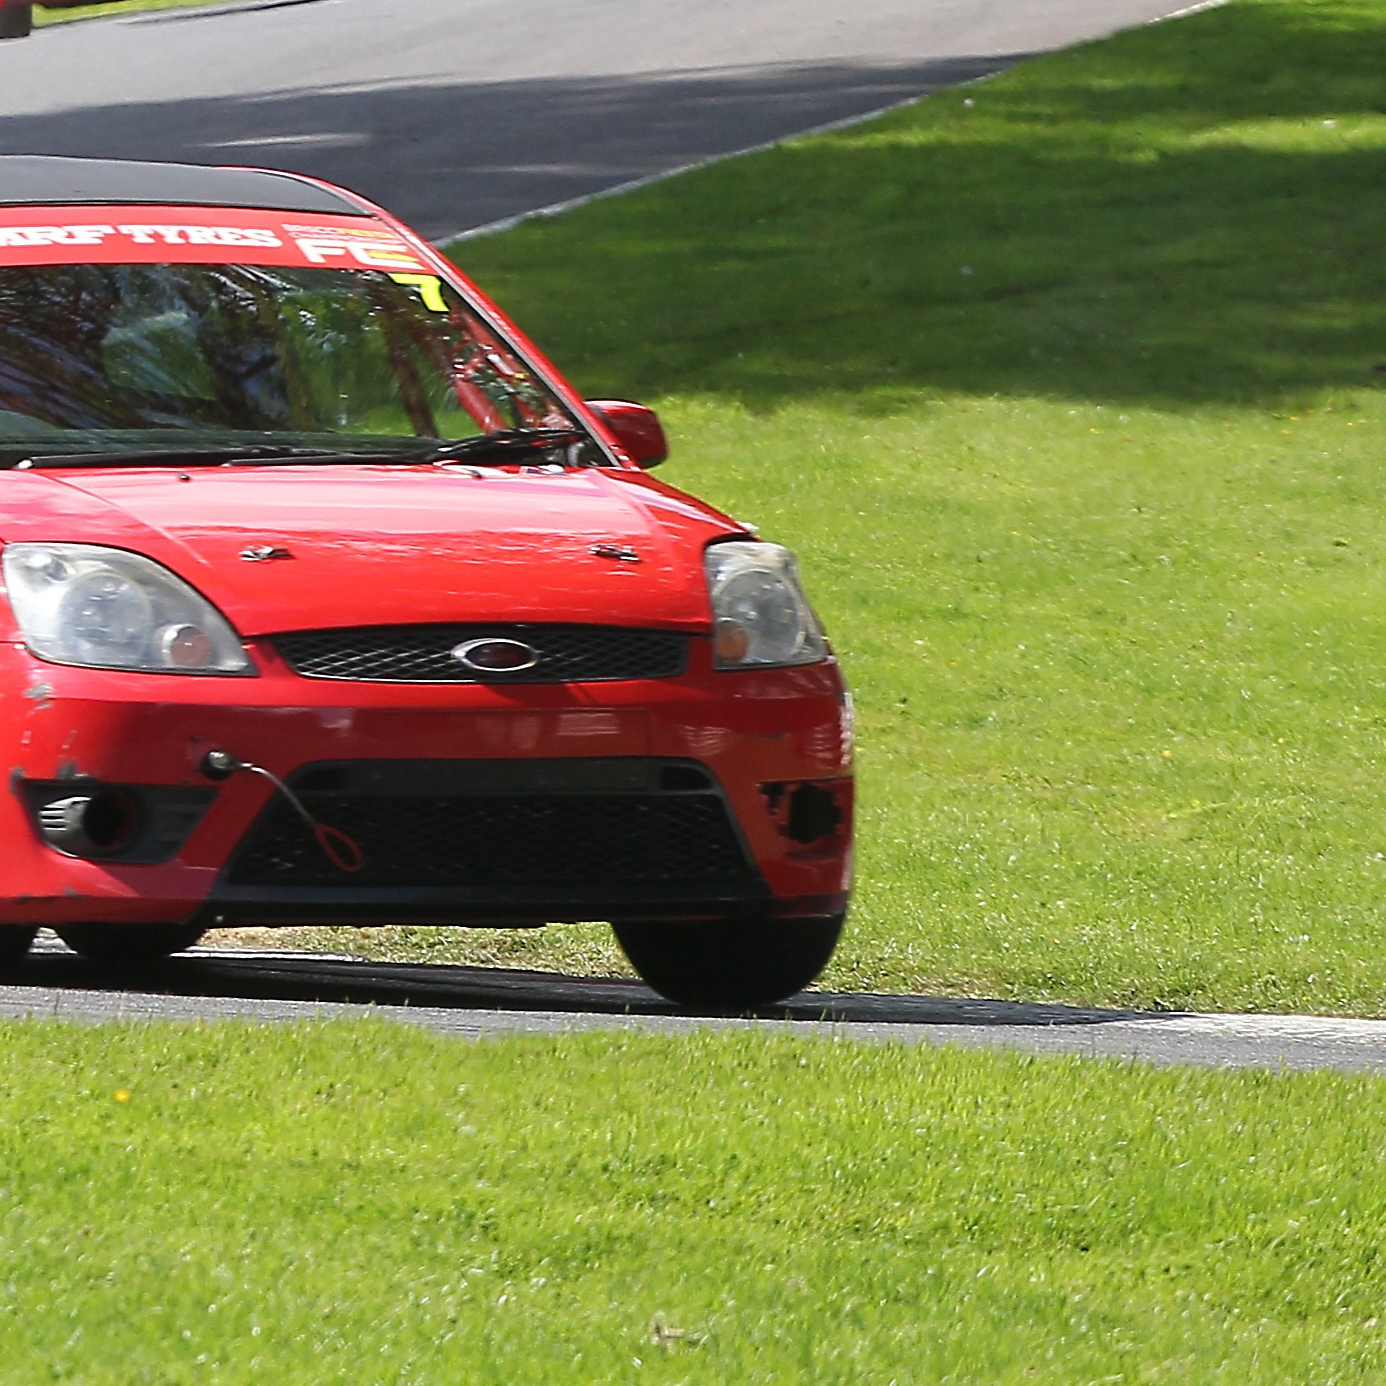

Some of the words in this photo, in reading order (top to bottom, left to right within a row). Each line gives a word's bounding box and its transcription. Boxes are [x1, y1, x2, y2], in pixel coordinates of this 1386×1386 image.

[116, 224, 283, 247] TYRES
[295, 238, 427, 270] FC
[386, 272, 450, 313] 7
